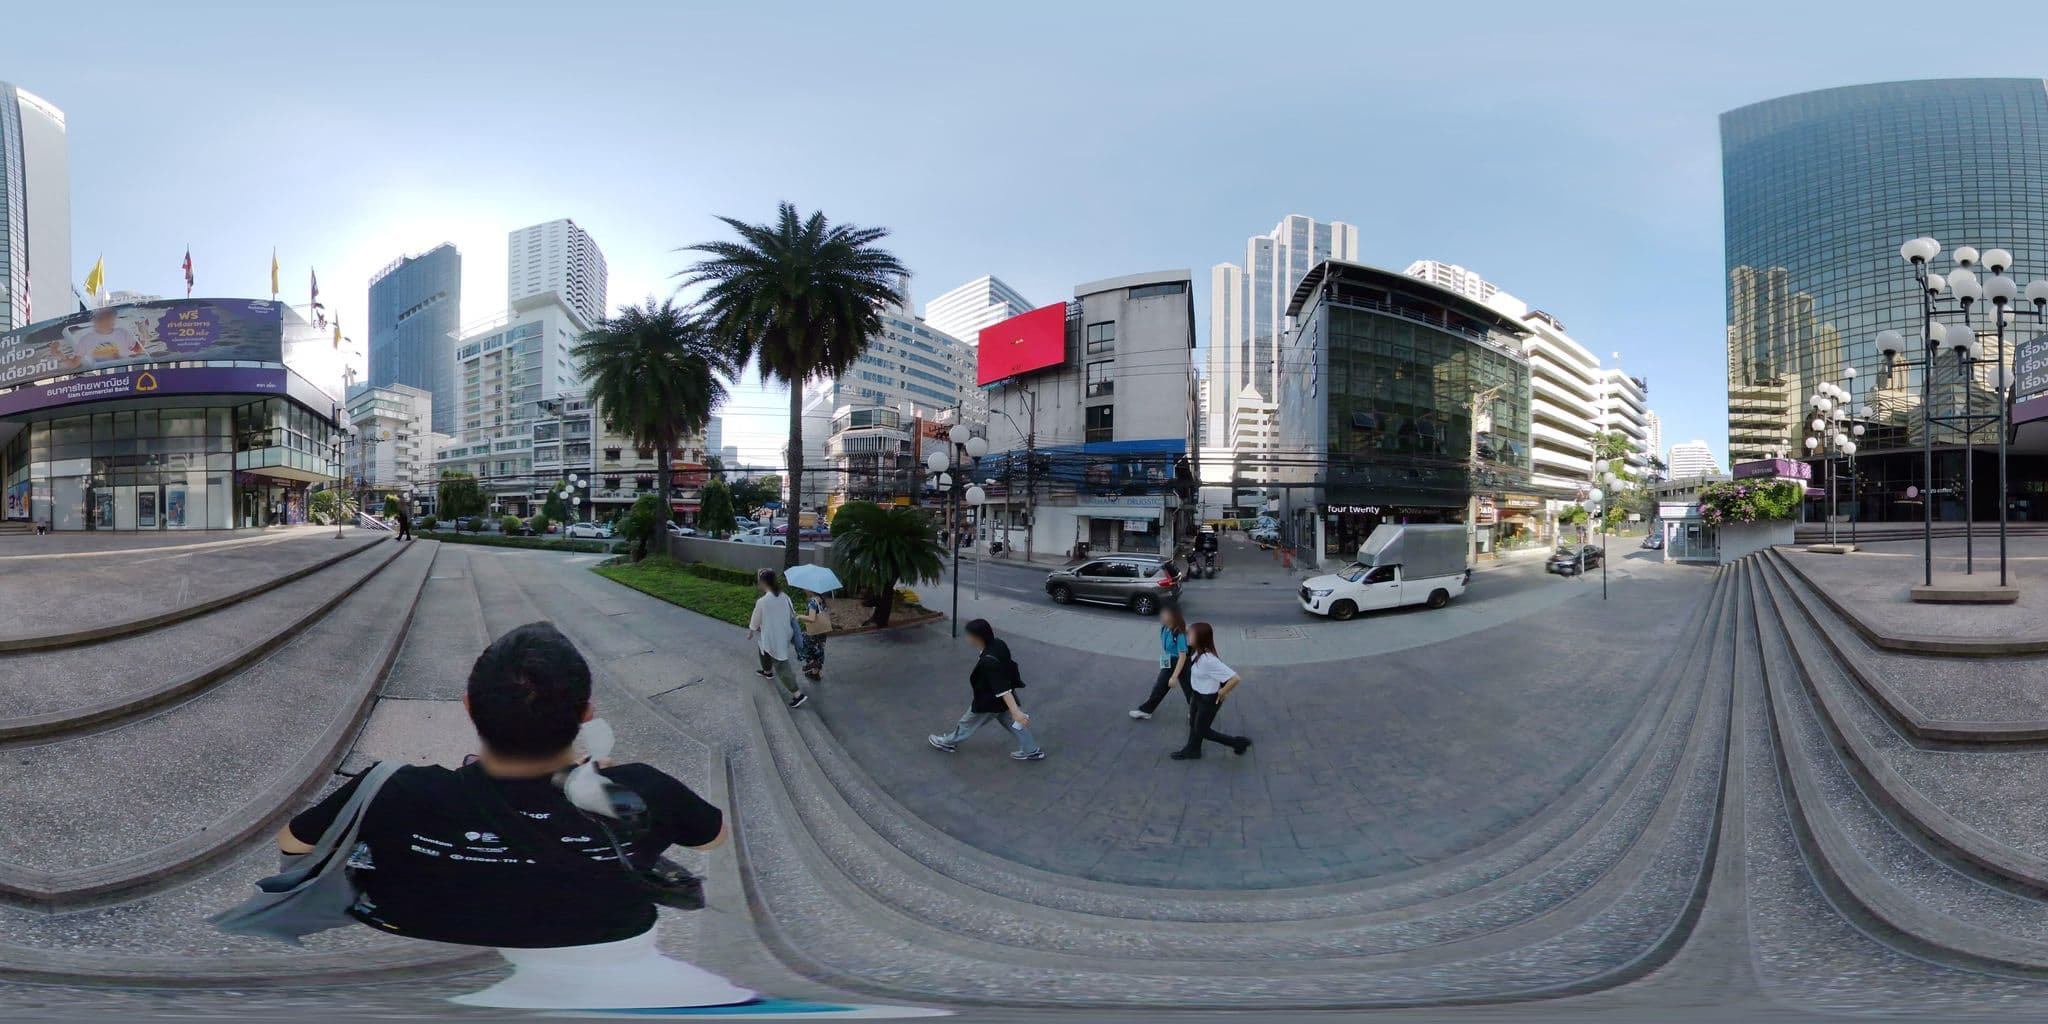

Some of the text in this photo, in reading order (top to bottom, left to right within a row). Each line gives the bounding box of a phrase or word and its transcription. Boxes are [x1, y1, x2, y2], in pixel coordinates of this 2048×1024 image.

[179, 309, 199, 320] ฟรี
[179, 329, 195, 337] 20
[2021, 356, 2048, 374] เรื่อง
[46, 376, 130, 396] ธนาคารไทยพาณิชย์
[2021, 372, 2048, 390] เรื่อง
[81, 388, 114, 397] Commercial
[1327, 504, 1380, 515] four twenty
